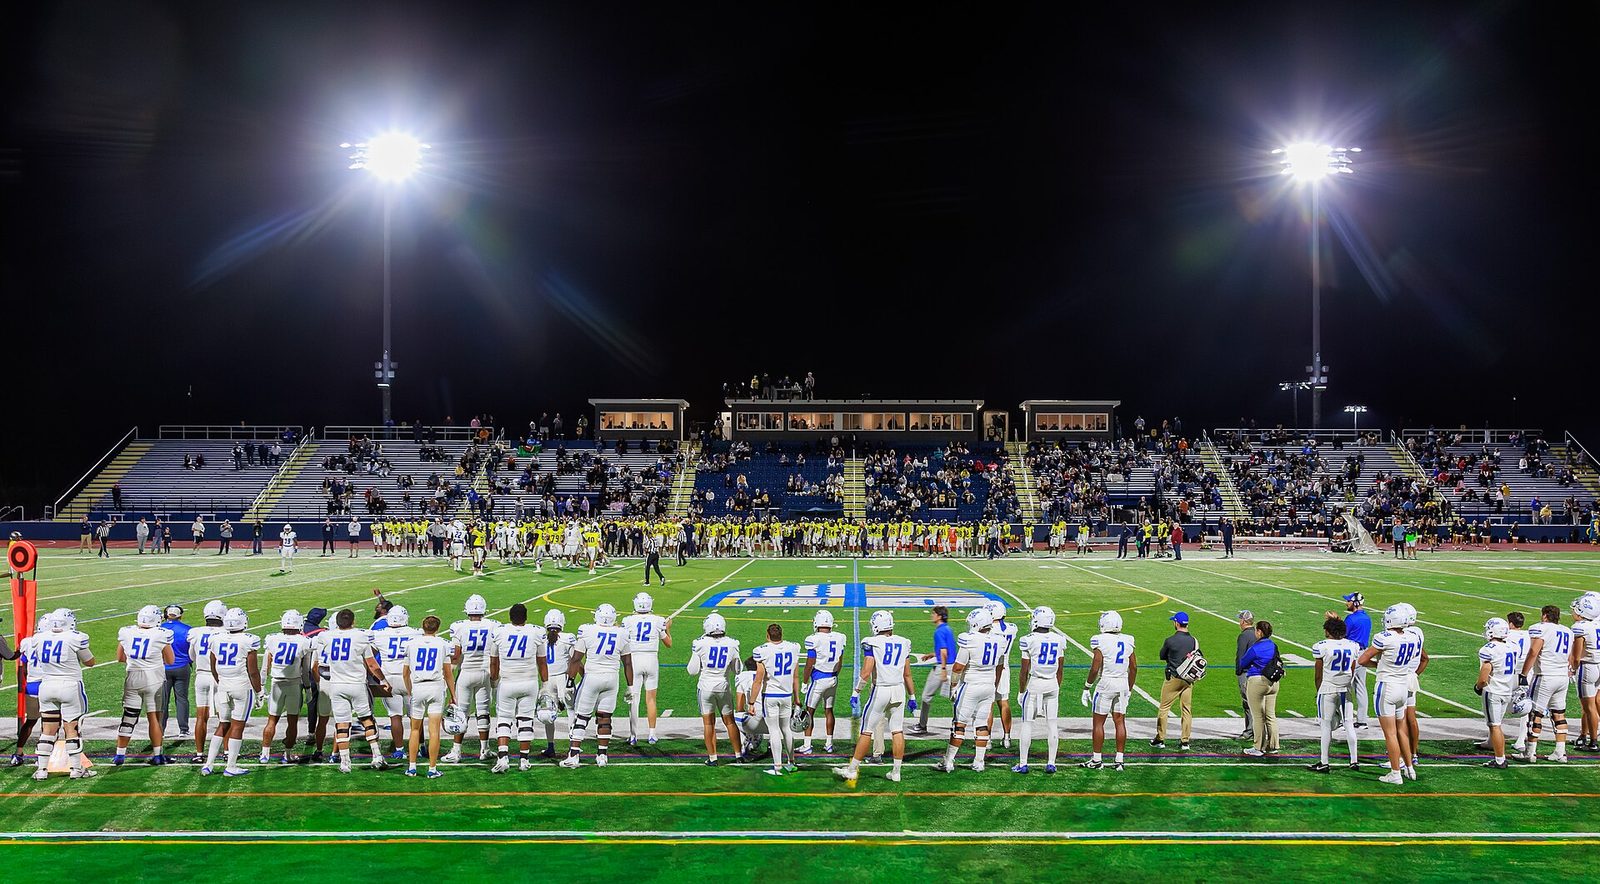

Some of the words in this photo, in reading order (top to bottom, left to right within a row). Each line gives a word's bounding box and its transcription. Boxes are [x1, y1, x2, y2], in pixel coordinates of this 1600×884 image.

[576, 426, 583, 435] 3
[467, 630, 488, 651] 53
[636, 622, 652, 641] 12
[1555, 631, 1569, 654] 79
[41, 640, 63, 664] 64
[130, 638, 149, 659] 51
[218, 643, 238, 667] 52
[274, 643, 297, 666] 20
[331, 637, 351, 661] 69
[507, 635, 527, 656] 74
[596, 632, 617, 655] 75
[828, 641, 837, 662] 5
[883, 643, 903, 666] 87
[982, 643, 998, 666] 61
[1038, 643, 1059, 666] 85
[1115, 642, 1125, 664] 2
[1394, 643, 1415, 666] 88
[415, 648, 438, 671] 98
[706, 647, 728, 669] 96
[774, 652, 793, 676] 92
[1332, 649, 1351, 672] 26
